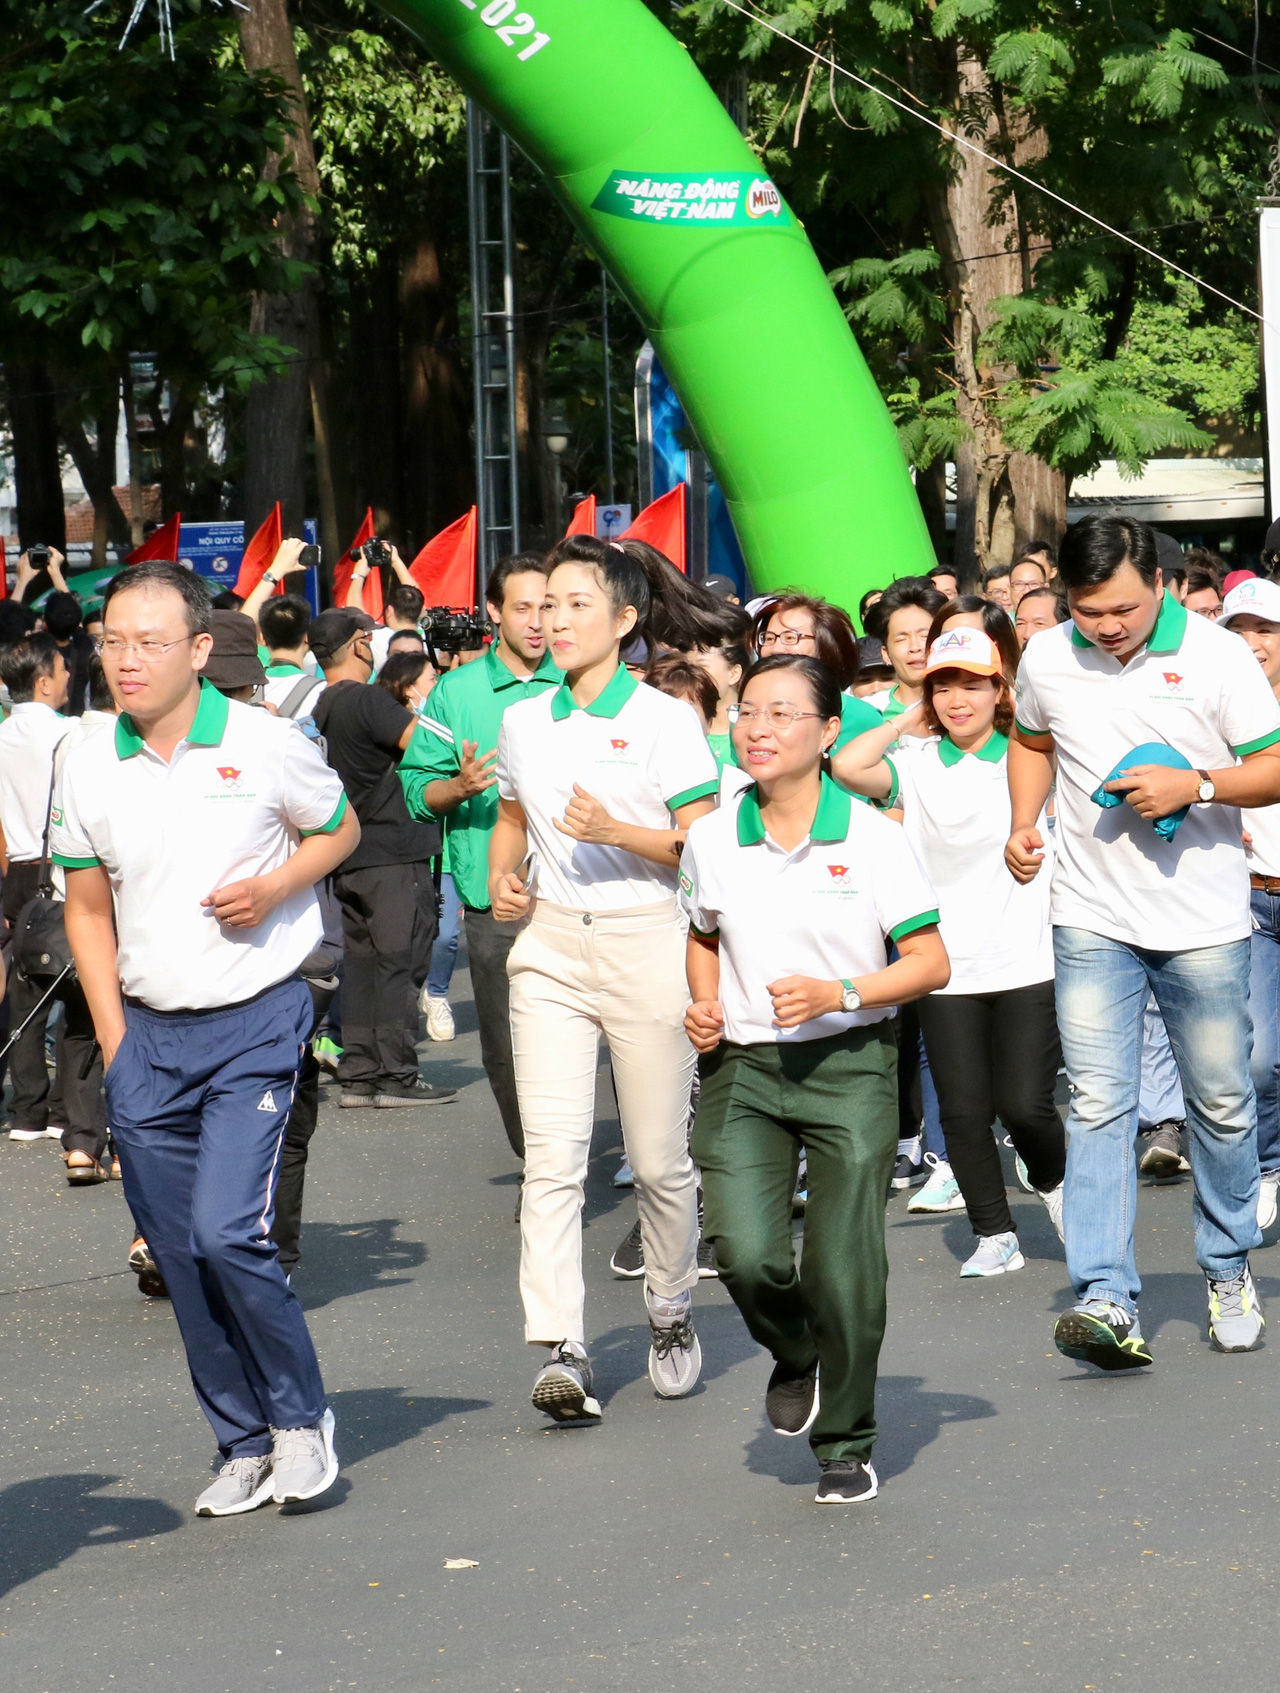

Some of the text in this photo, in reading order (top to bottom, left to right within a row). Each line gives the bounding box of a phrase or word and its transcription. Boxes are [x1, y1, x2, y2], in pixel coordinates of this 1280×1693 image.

[459, 0, 551, 61] 021
[614, 178, 740, 202] NĂNG ĐỘNG
[752, 190, 779, 208] MILO
[630, 198, 737, 220] VIỆT NAM
[214, 537, 231, 545] QUY
[233, 535, 244, 544] CÔ
